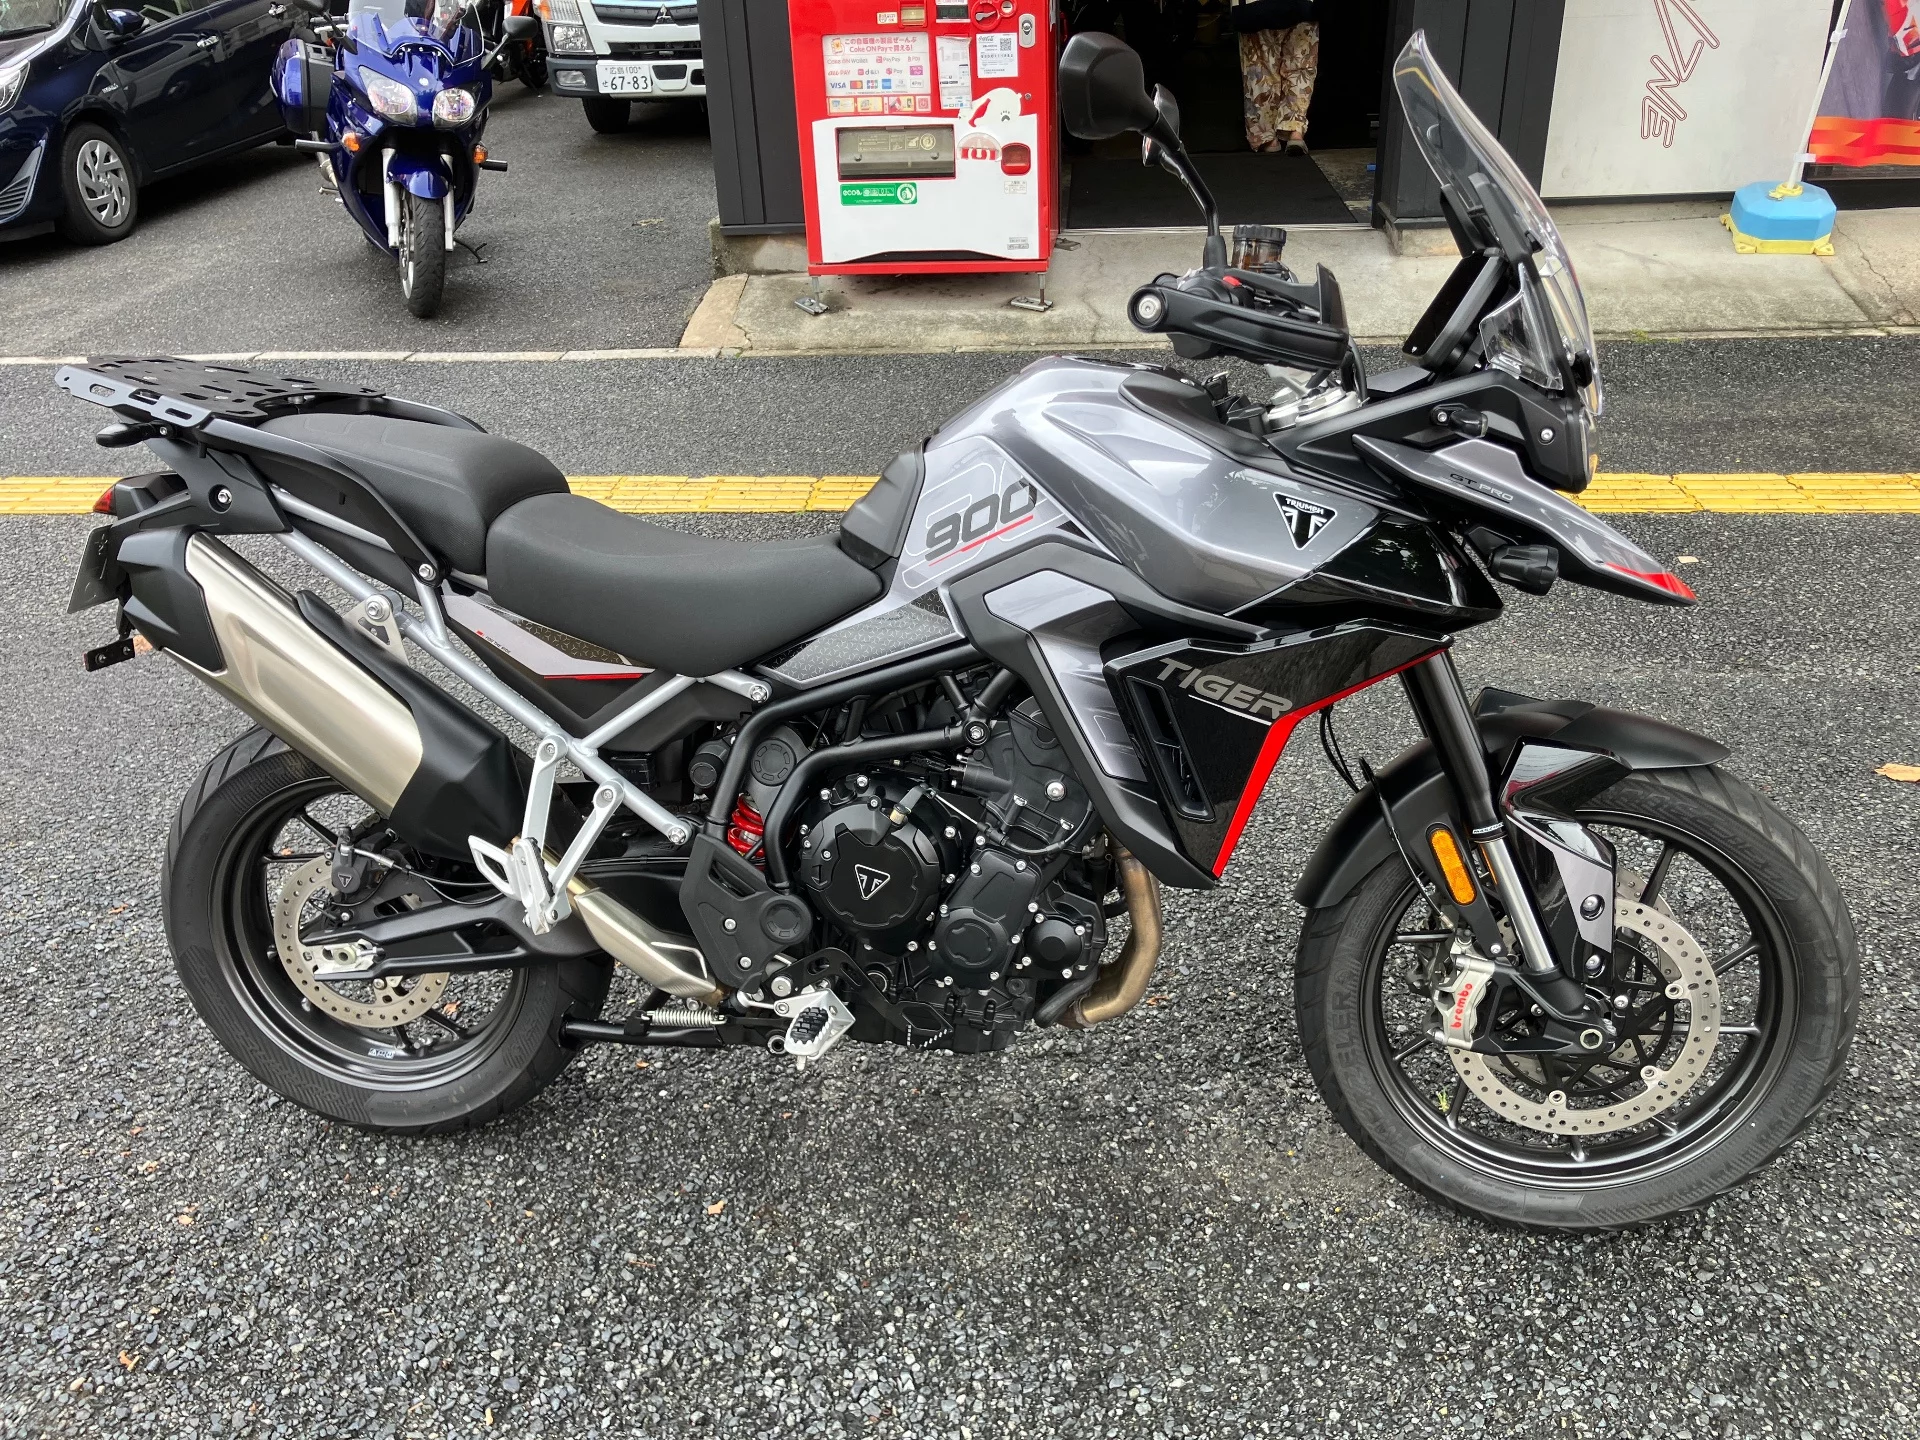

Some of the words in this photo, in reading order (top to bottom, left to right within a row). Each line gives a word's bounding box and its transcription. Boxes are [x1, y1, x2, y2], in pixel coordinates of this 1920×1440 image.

[610, 76, 648, 90] 67-83
[625, 66, 638, 74] 100
[1450, 473, 1477, 485] GT
[1479, 483, 1514, 501] PRO
[925, 477, 1038, 561] 900
[1285, 497, 1324, 515] TRIUMPH
[1157, 658, 1293, 720] TIGER
[1450, 983, 1473, 1029] brembo
